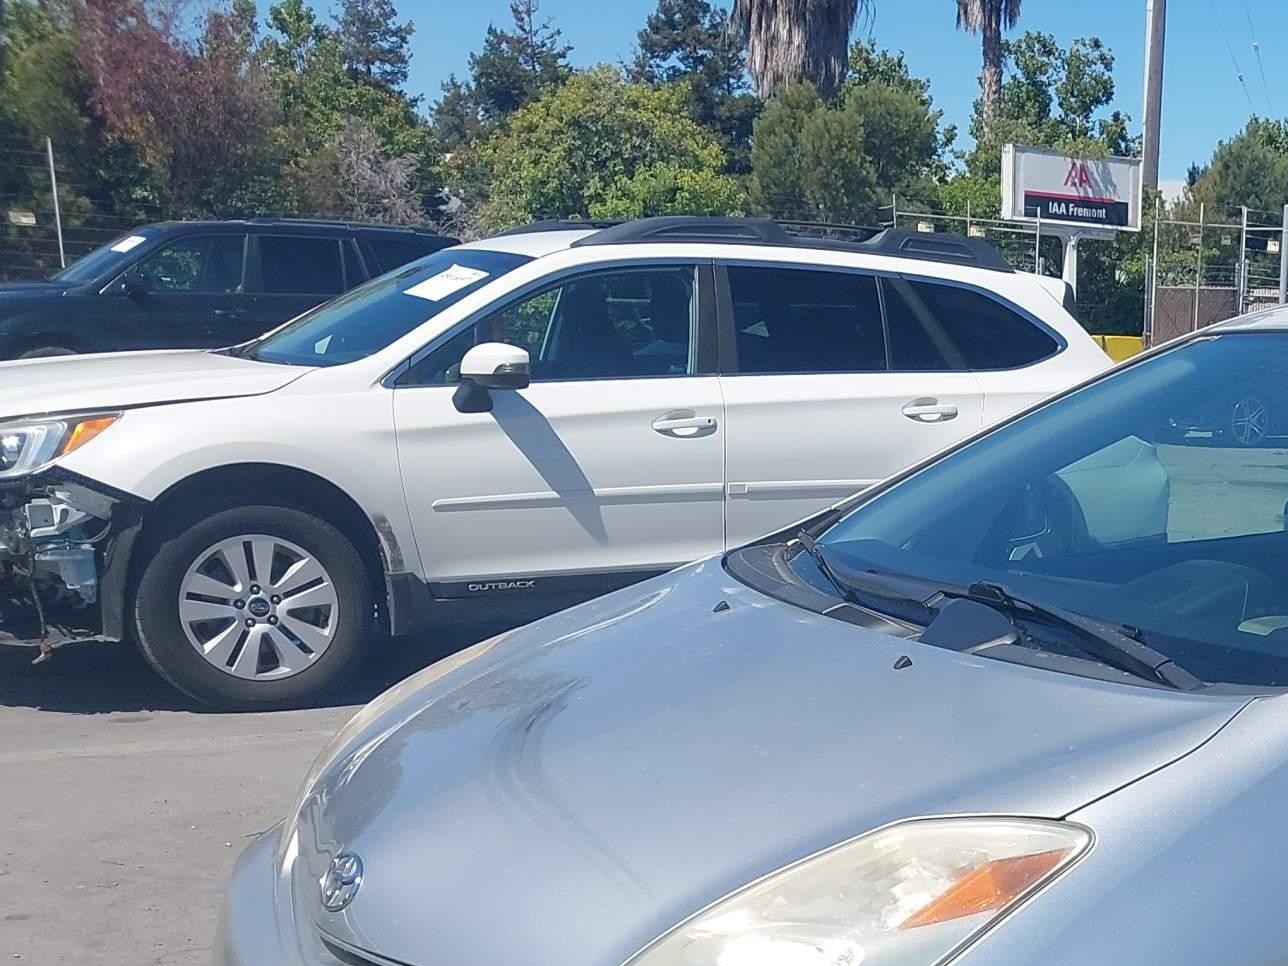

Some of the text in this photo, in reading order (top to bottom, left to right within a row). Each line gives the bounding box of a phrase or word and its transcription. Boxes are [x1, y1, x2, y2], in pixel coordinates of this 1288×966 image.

[1048, 201, 1106, 219] IAA Fremont
[468, 580, 535, 591] OUTBACK
